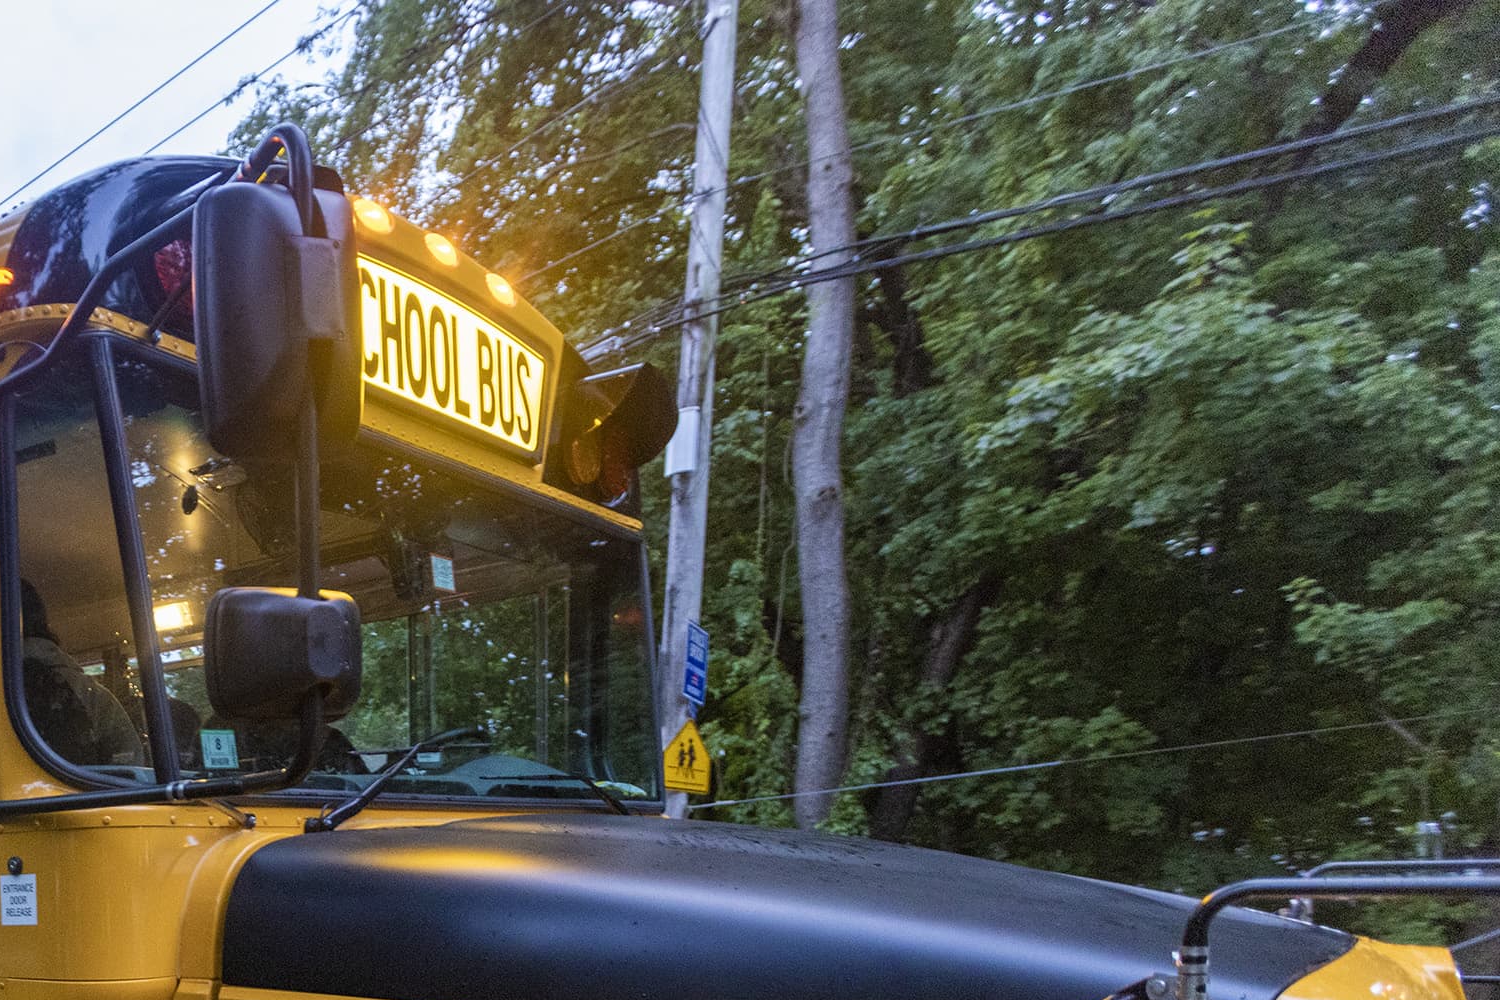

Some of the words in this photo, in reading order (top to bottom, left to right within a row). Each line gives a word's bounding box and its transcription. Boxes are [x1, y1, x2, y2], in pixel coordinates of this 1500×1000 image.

[361, 265, 471, 420] CHOOL
[476, 328, 532, 447] BUS
[3, 883, 34, 893] ENTRANCE
[10, 896, 27, 905] DOOR
[6, 907, 32, 917] RELEASE
